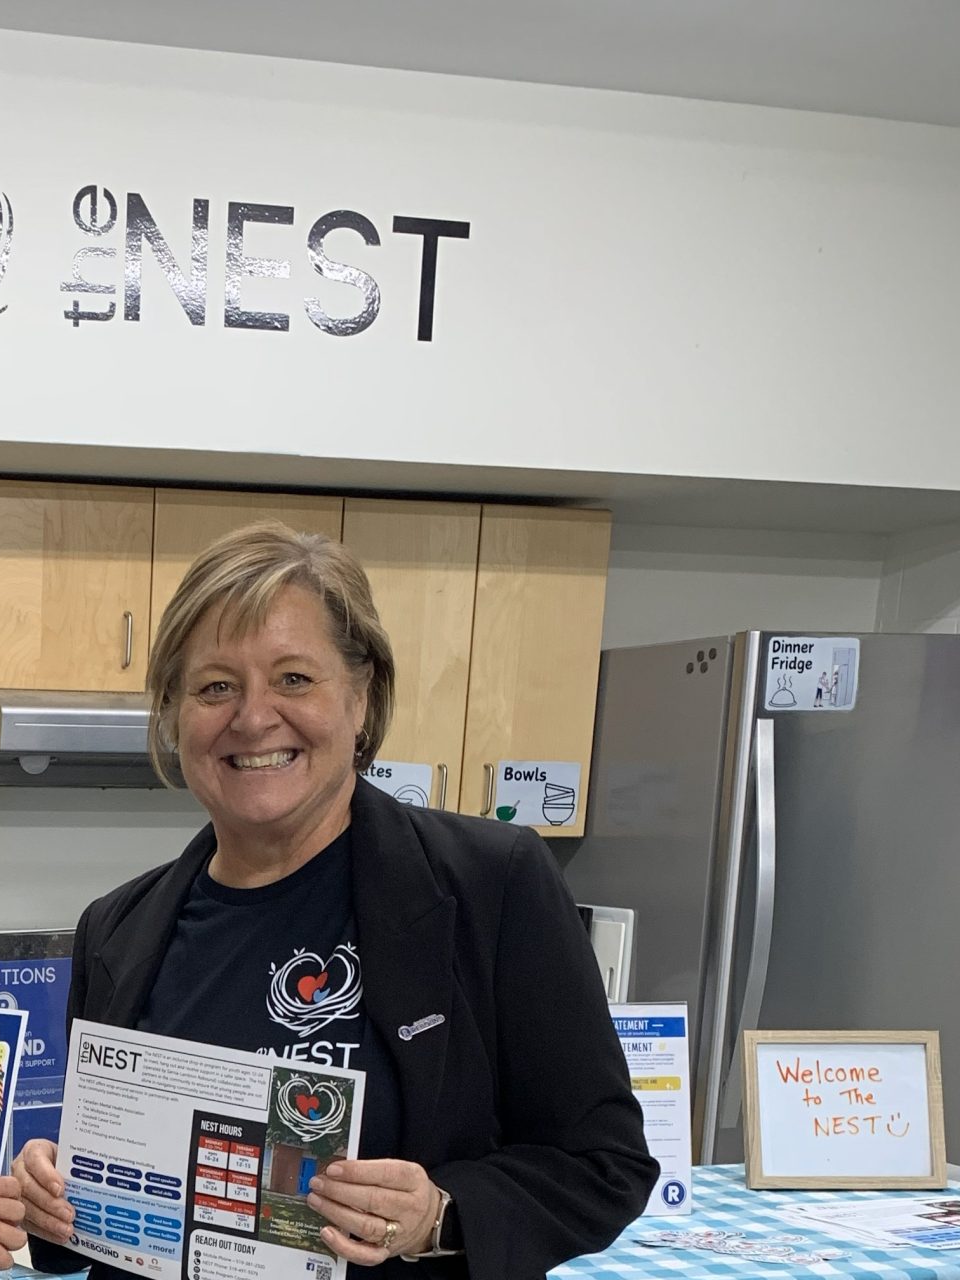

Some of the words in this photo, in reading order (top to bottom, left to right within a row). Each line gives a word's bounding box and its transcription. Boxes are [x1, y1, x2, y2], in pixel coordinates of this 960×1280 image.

[61, 185, 117, 327] the
[123, 192, 471, 342] NEST
[772, 639, 814, 654] Dinner
[771, 656, 812, 673] Fridge
[362, 763, 392, 778] ates
[503, 767, 547, 783] Bowls
[613, 1020, 649, 1030] ATEMENT
[623, 1042, 652, 1052] TEMENT
[25, 1059, 55, 1068] SUPPORT
[80, 1042, 90, 1063] the
[89, 1044, 142, 1073] NEST
[776, 1058, 882, 1084] Welcome
[802, 1088, 822, 1106] to
[840, 1088, 877, 1105] The
[200, 1120, 218, 1133] NEST
[219, 1124, 243, 1137] HOURS
[814, 1116, 882, 1136] NEST
[668, 1186, 680, 1202] R
[80, 1240, 119, 1259] REBOUND
[194, 1234, 218, 1248] REACH
[218, 1239, 232, 1250] OUT
[232, 1242, 256, 1255] TODAY
